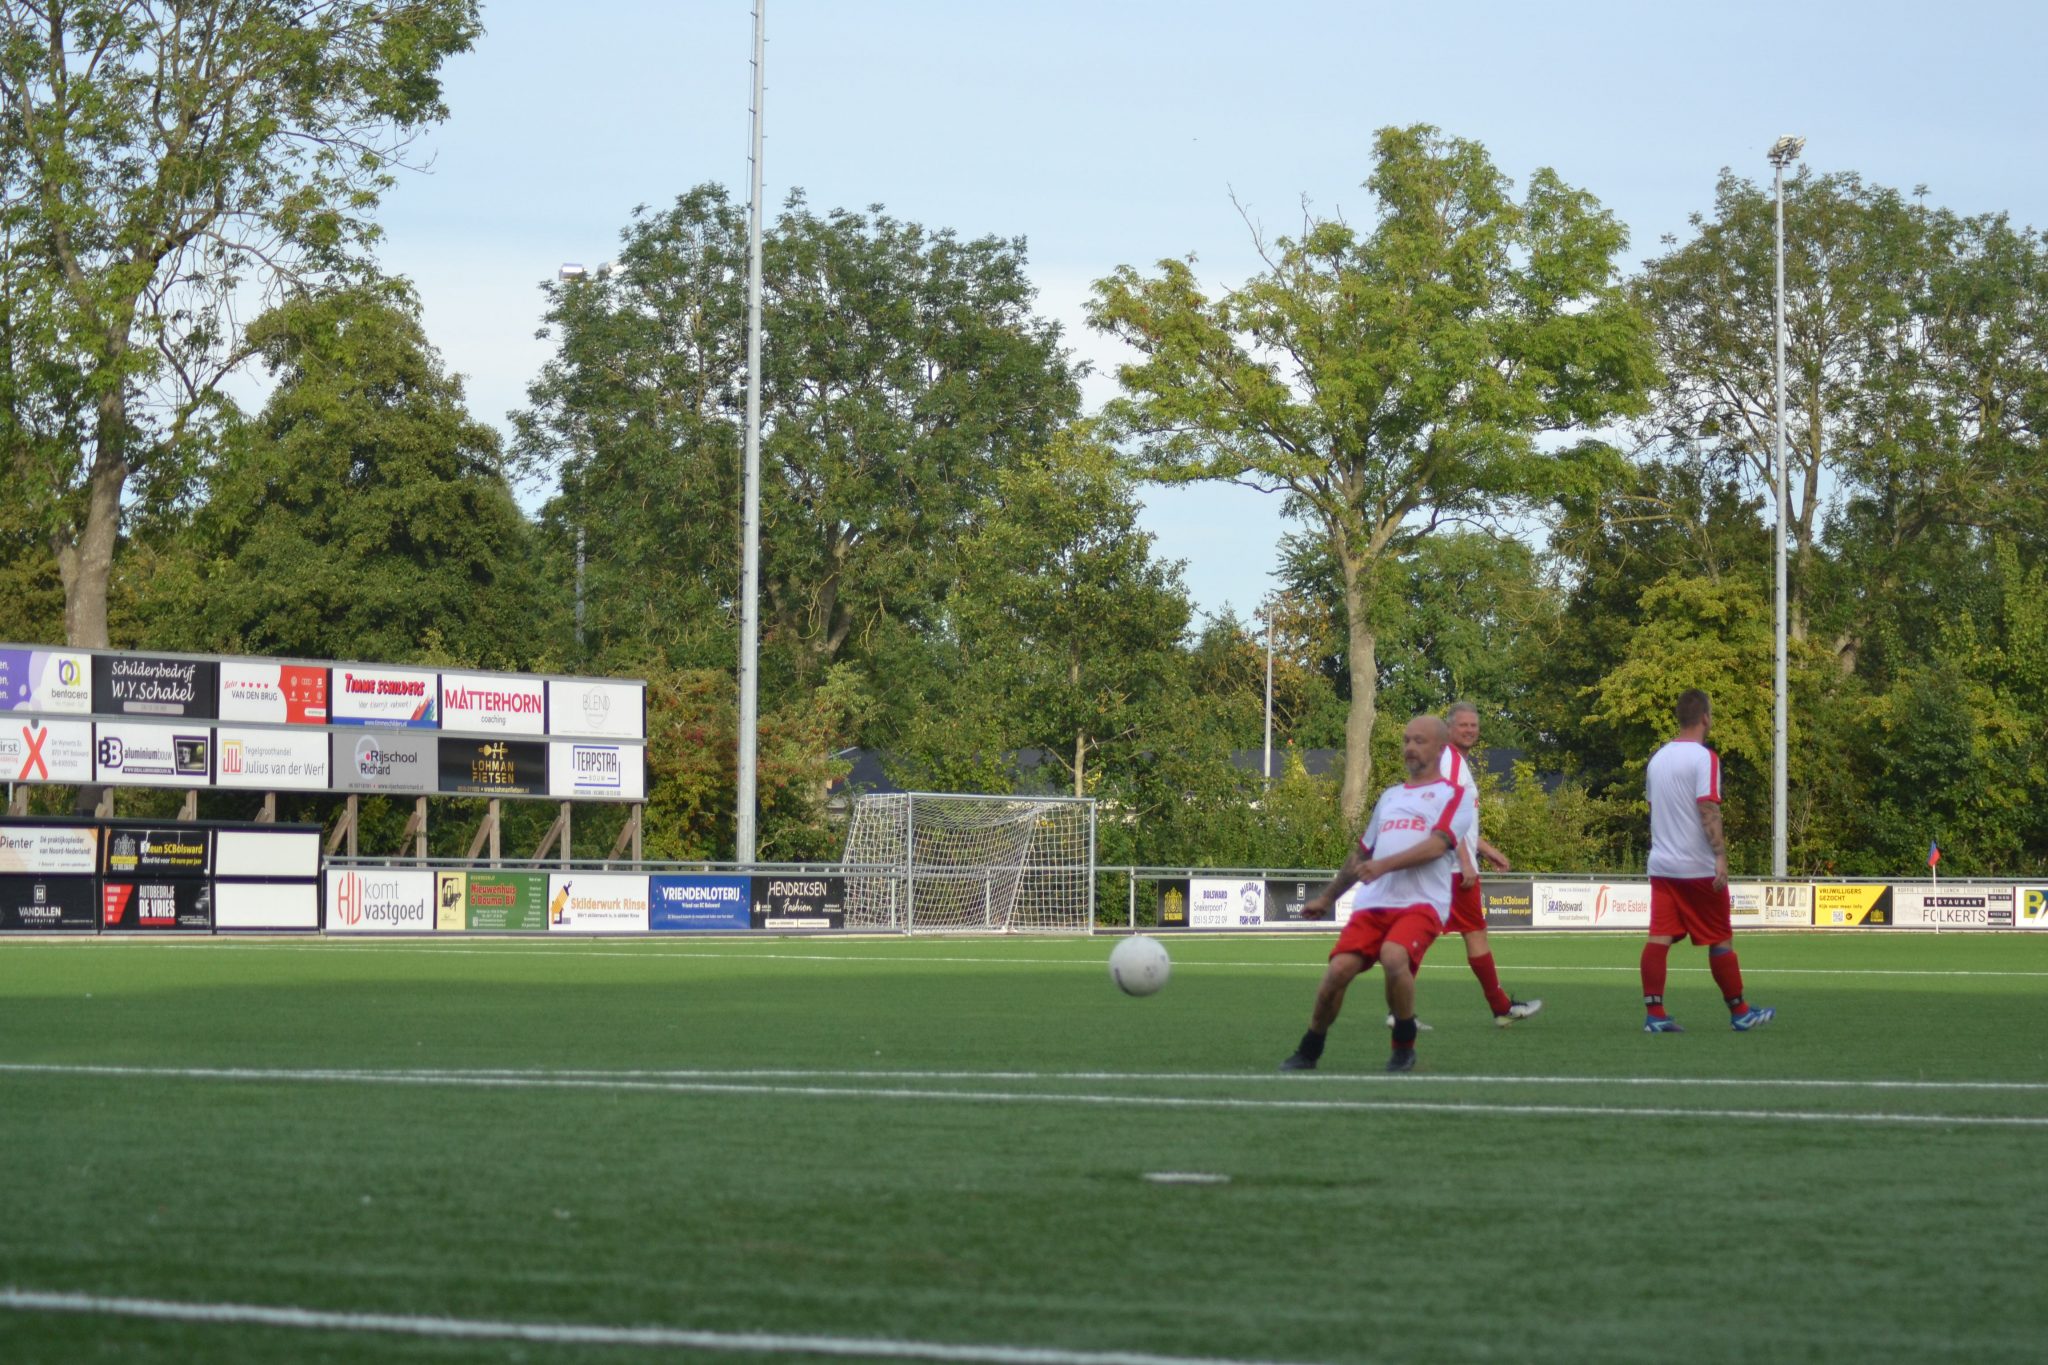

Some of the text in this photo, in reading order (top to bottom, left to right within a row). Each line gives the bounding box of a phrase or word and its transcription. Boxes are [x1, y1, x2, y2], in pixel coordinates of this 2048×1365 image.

[112, 660, 196, 682] Schildersbedrijf
[246, 692, 260, 700] DEN
[261, 692, 278, 701] BRUG
[445, 684, 542, 714] MATTERHORN
[481, 715, 506, 726] coaching
[124, 747, 172, 760] aluminiumbouw
[246, 746, 292, 758] Tegelgroothandel
[370, 750, 418, 764] Rijschool
[244, 761, 324, 776] Julius van der Werf
[472, 760, 514, 772] LOHMAN
[576, 752, 617, 772] TERPSTRA
[360, 763, 390, 776] Richard
[472, 772, 514, 784] FIETSEN
[140, 884, 175, 898] AUTOBEDRIJF
[364, 877, 400, 900] komt
[470, 883, 518, 895] Nieuwenhuis
[662, 886, 740, 902] VRIENDENLOTERIJ
[768, 881, 826, 896] HENDRIKSEN
[1203, 890, 1228, 900] BOLSWARD
[1240, 882, 1261, 898] MIEDEMA
[140, 899, 176, 918] DE VRIES
[570, 898, 646, 910] Skilderwurk Rinse
[782, 896, 812, 915] Fashion
[1612, 900, 1648, 912] Parc Estate
[18, 906, 62, 918] VANDILLEN
[364, 898, 424, 926] vastgoed
[1923, 909, 1986, 923] FOLKERTS
